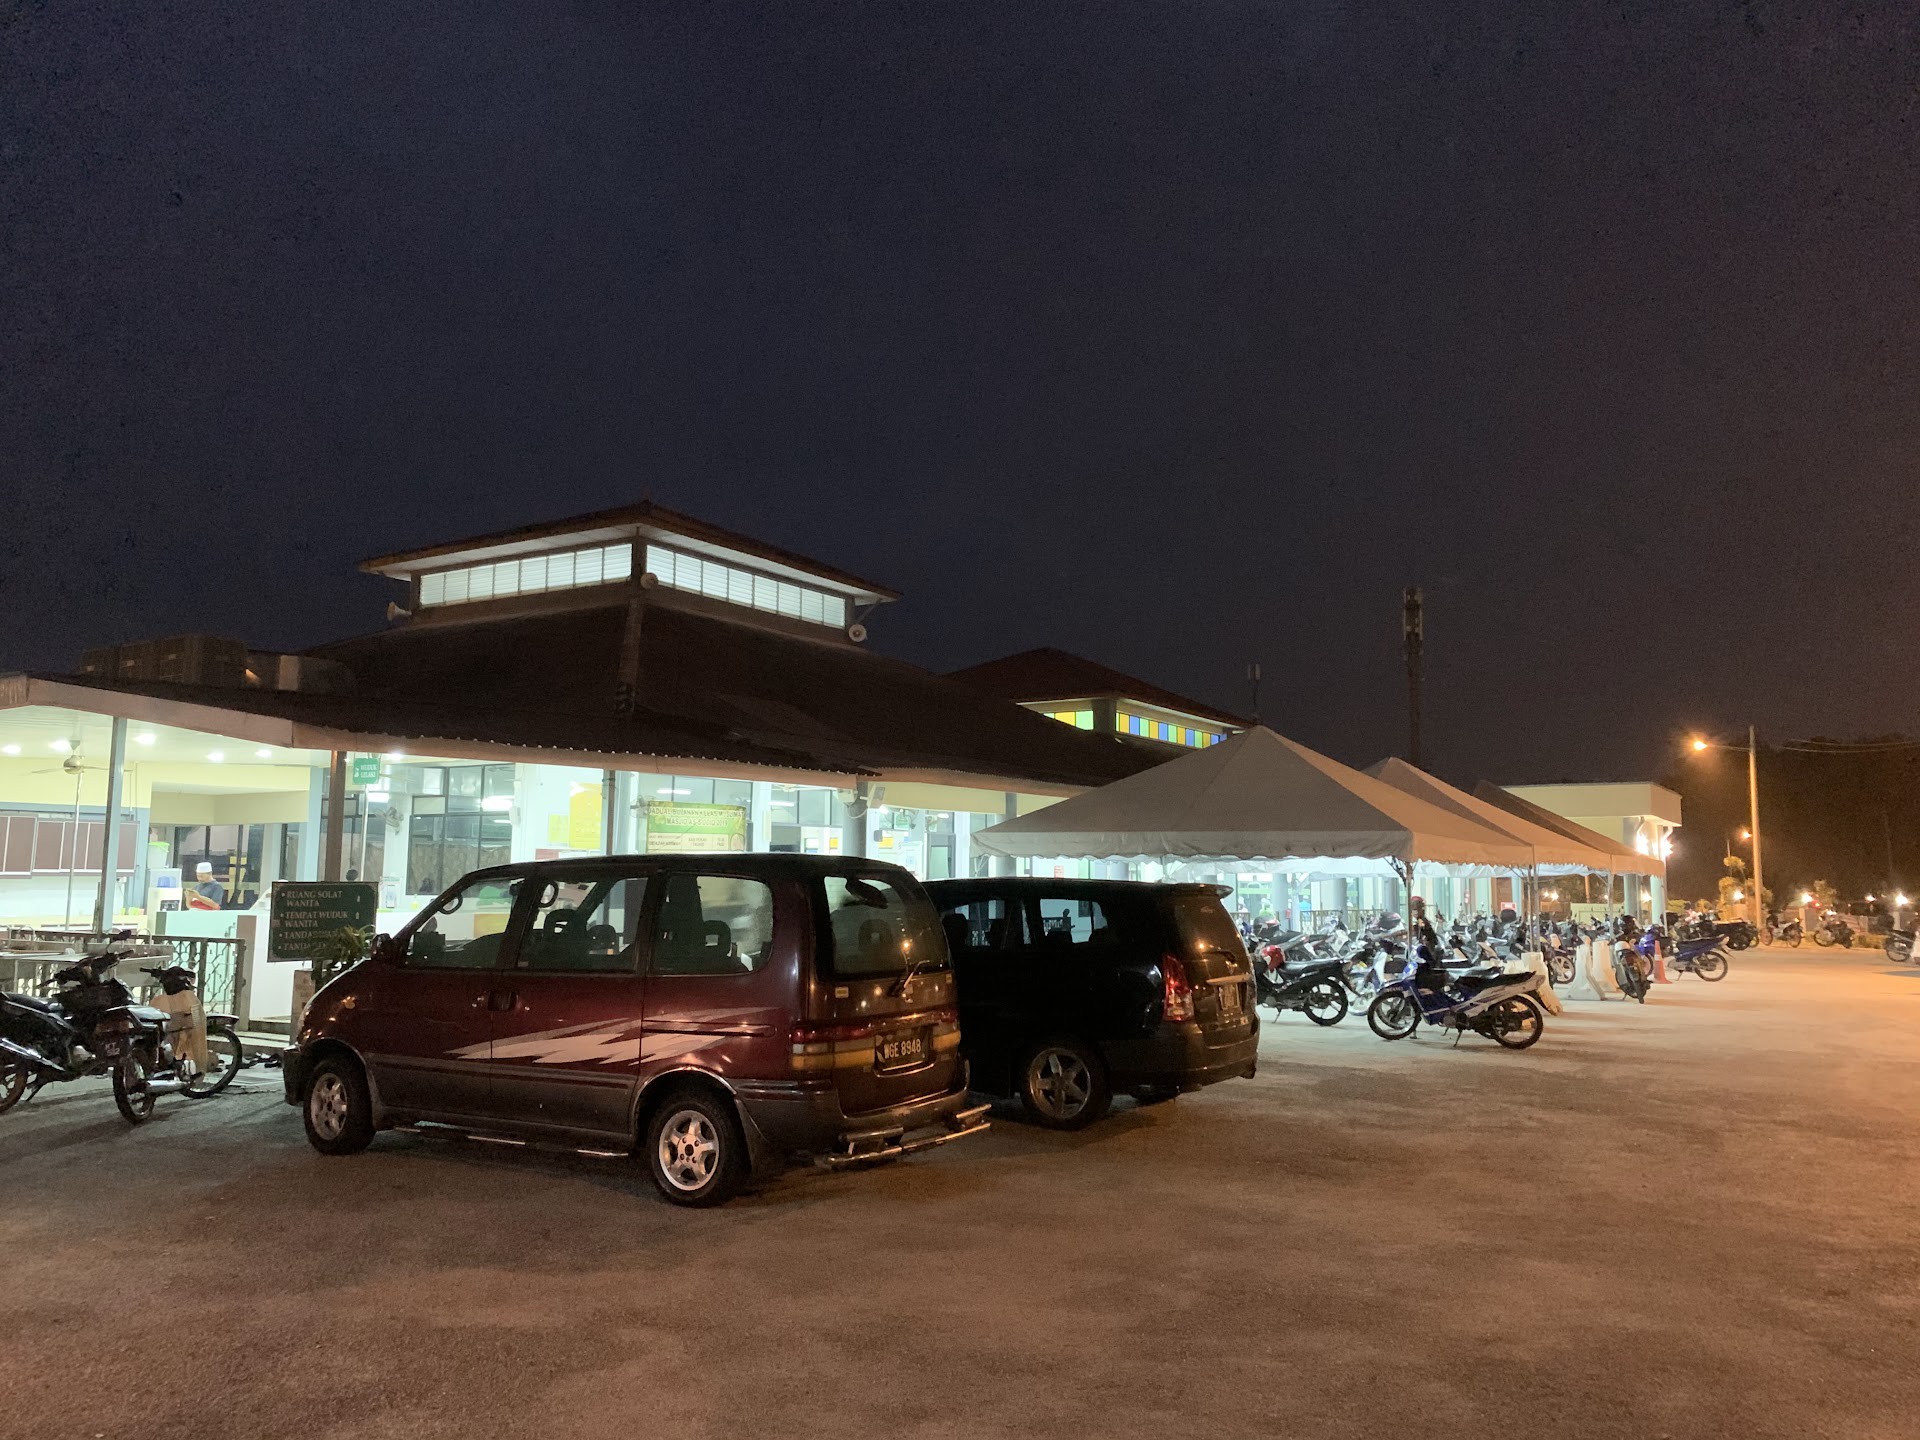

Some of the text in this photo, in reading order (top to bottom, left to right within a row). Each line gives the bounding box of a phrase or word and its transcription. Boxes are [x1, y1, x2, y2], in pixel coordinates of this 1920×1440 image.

[286, 890, 343, 900] RUANG SOLAT
[286, 899, 320, 908] WANITA
[285, 911, 348, 920] TEMPAT WUDUK
[284, 919, 319, 928] WANITA
[883, 1038, 922, 1059] WGE 8948
